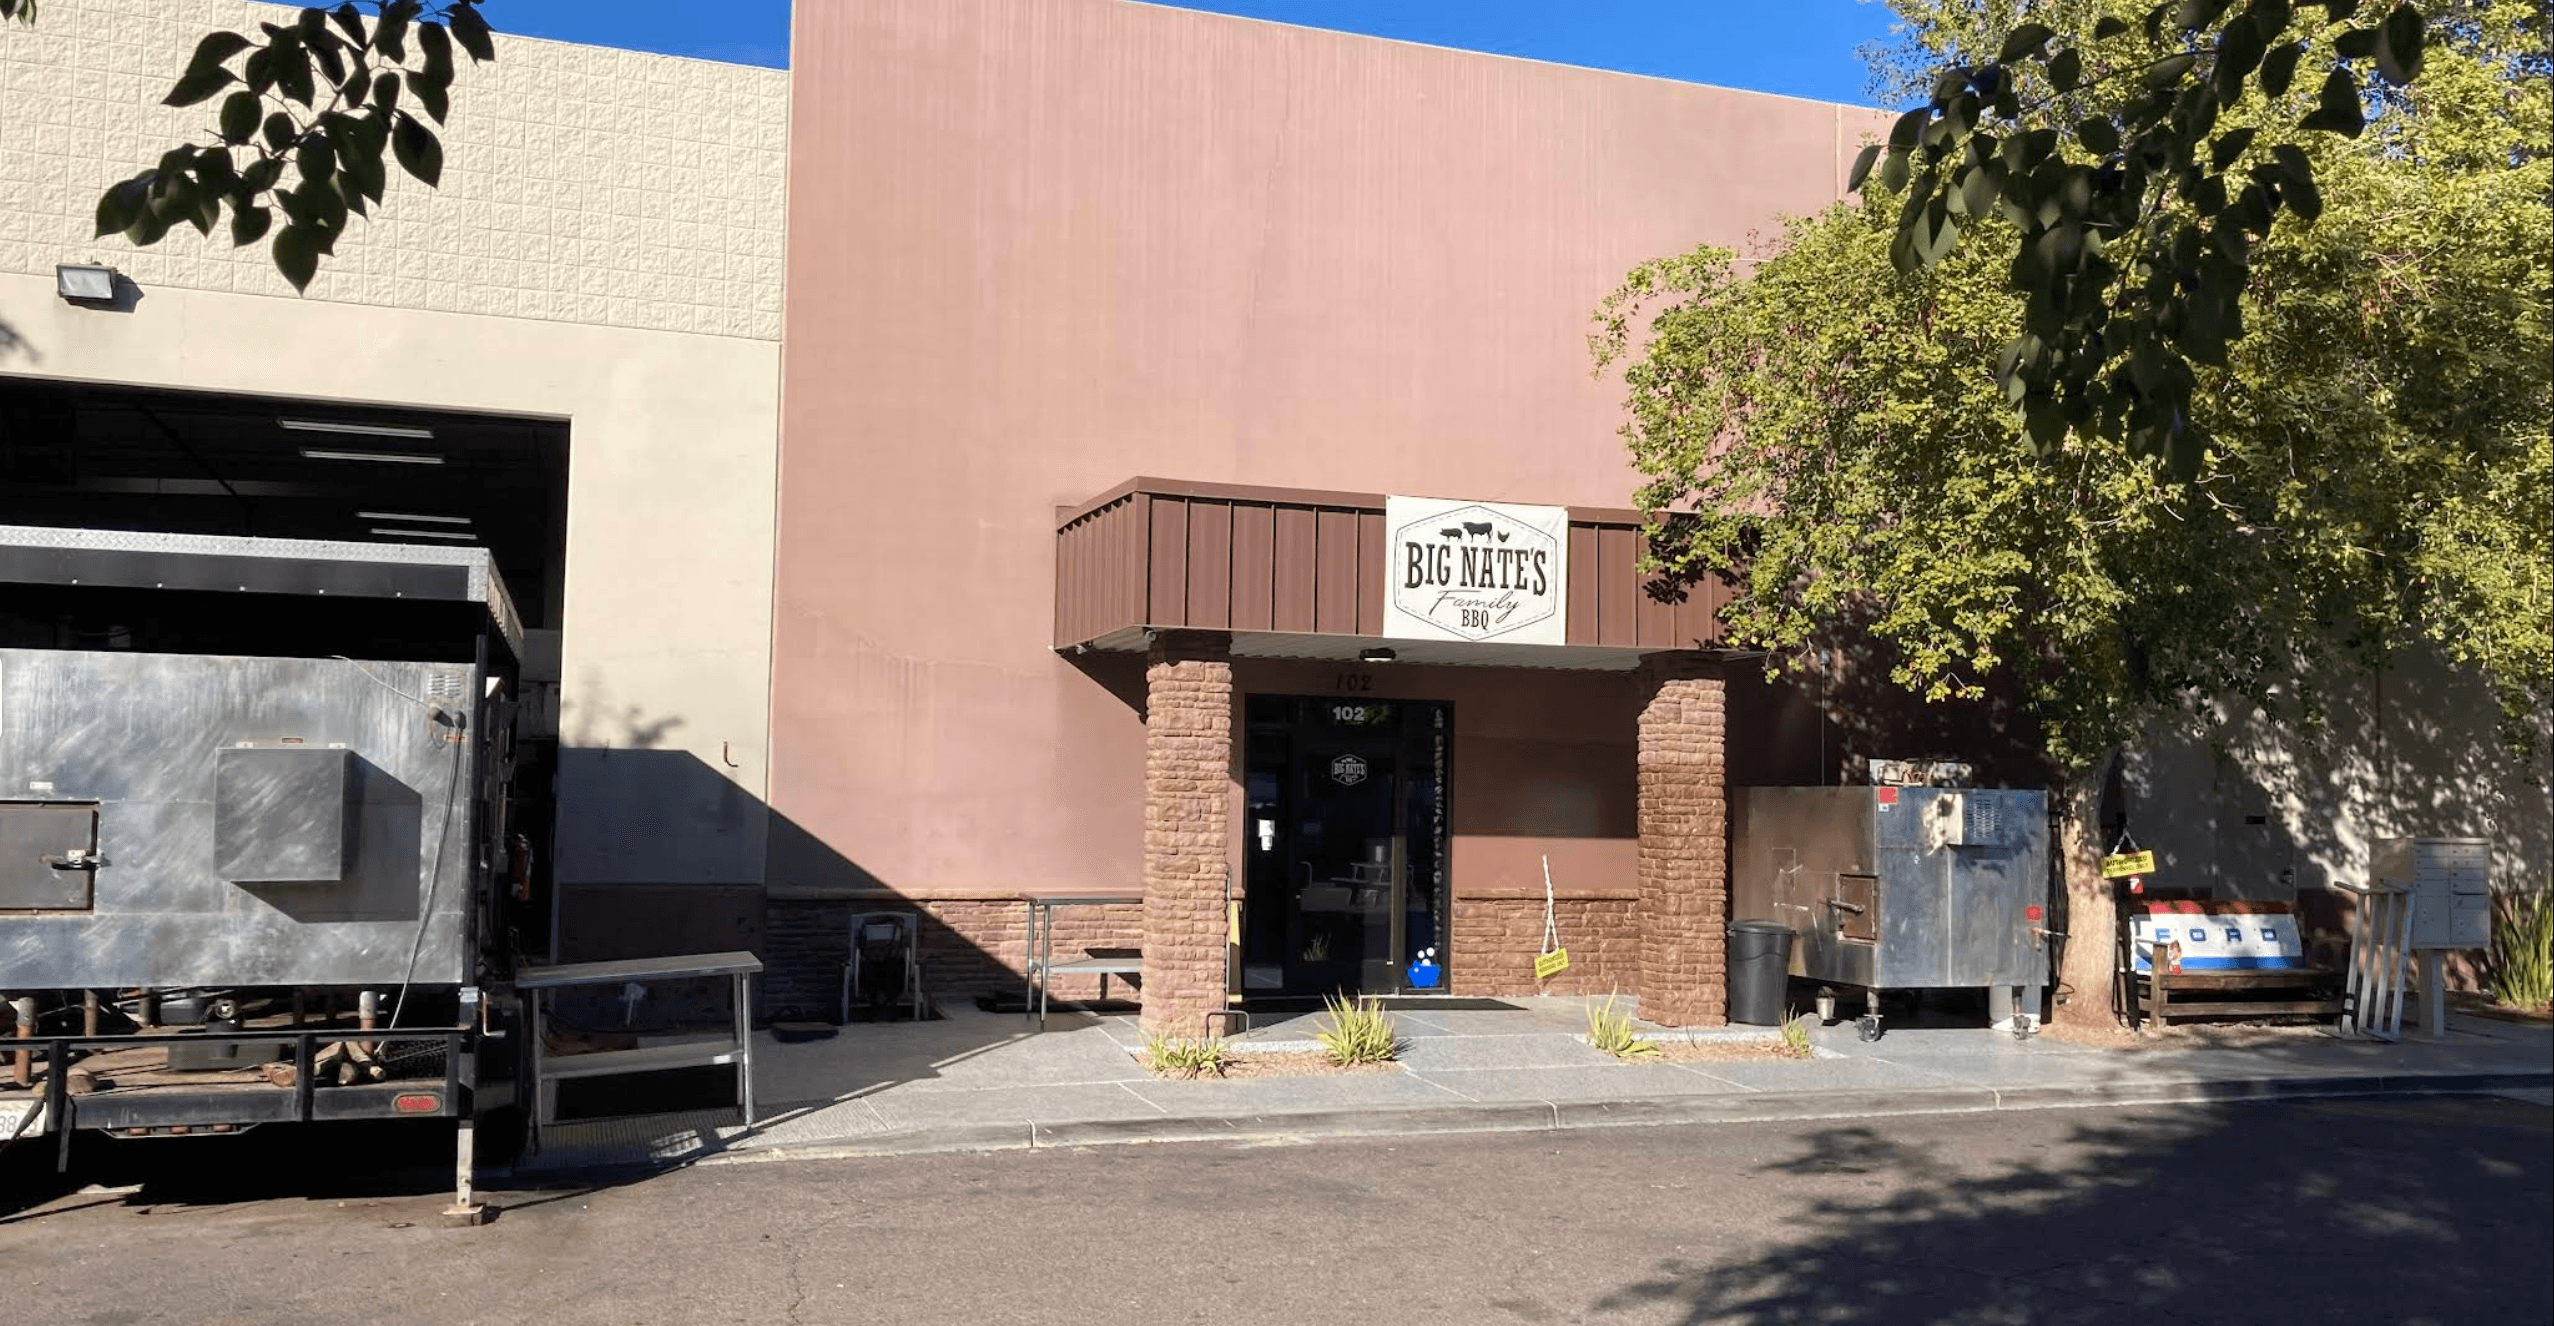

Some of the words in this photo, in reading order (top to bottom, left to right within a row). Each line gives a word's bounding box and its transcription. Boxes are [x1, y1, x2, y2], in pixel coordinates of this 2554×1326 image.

[1404, 541, 1451, 589] BIG
[1459, 546, 1547, 597] NATE'S
[1429, 590, 1520, 624] Family
[1461, 608, 1489, 631] BBQ
[1336, 673, 1372, 691] 102
[1332, 706, 1365, 720] 102
[2154, 928, 2278, 943] FORD
